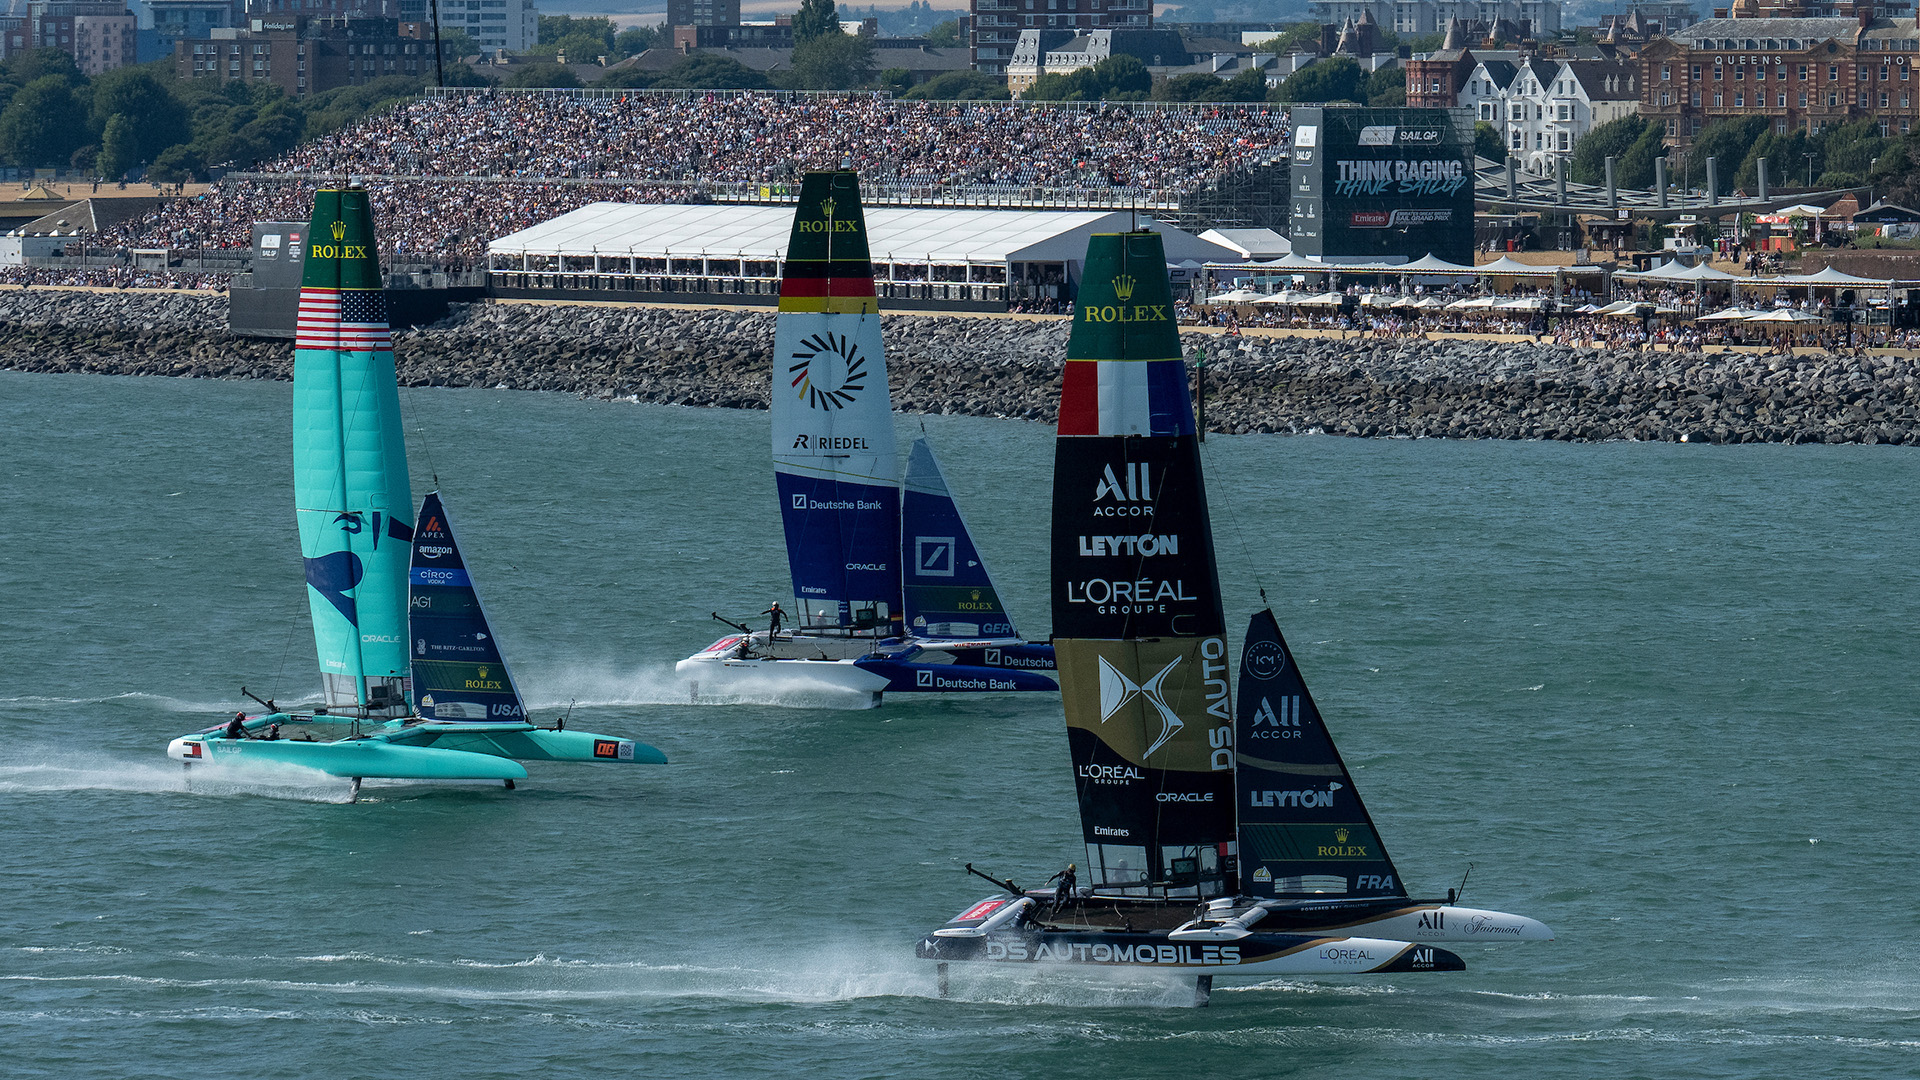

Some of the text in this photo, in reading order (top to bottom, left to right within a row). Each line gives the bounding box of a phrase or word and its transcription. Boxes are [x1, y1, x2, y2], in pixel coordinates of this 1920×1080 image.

[263, 22, 285, 31] Holiday
[1714, 56, 1782, 65] QUEENS
[1336, 160, 1462, 181] THINK RACING
[1334, 175, 1468, 198] THINK SAILGP
[1354, 215, 1386, 223] Emirates
[1618, 210, 1629, 219] BAR
[799, 220, 858, 232] ROLEX
[312, 245, 368, 259] ROLEX
[1084, 305, 1168, 322] ROLEX
[819, 437, 869, 449] RIEDEL
[810, 500, 882, 510] Deutsche Bank
[1093, 506, 1154, 517] ACCOR
[421, 531, 444, 539] APEX
[419, 545, 453, 556] amazon
[1079, 533, 1179, 557] LEYTON
[845, 563, 886, 571] ORACLE
[420, 569, 453, 579] CÎROC
[801, 585, 827, 595] Emirates
[1068, 577, 1198, 605] L'ORÉAL
[411, 595, 431, 608] AG1
[958, 602, 993, 610] ROLEX
[1098, 604, 1166, 615] GROUPE
[982, 622, 1011, 634] GER
[361, 634, 401, 643] ORACLE
[1004, 655, 1054, 669] Deutsche
[465, 679, 502, 690] ROLEX
[936, 677, 1017, 691] Deutsche Bank
[491, 703, 522, 717] USA
[1201, 637, 1234, 771] DS AUTO
[1251, 730, 1302, 739] ACCOR
[1079, 764, 1145, 779] L'ORÉAL
[1094, 778, 1130, 786] GROUPE
[1155, 792, 1214, 802] ORACLE
[1251, 789, 1334, 808] LEYTON
[1094, 825, 1130, 838] Emirates
[1317, 846, 1367, 857] ROLEX
[1356, 874, 1395, 890] FRA
[1464, 914, 1525, 936] Fairmont
[987, 941, 1242, 965] DS AUTOMOBILES
[1319, 948, 1375, 960] L'ORÉAL
